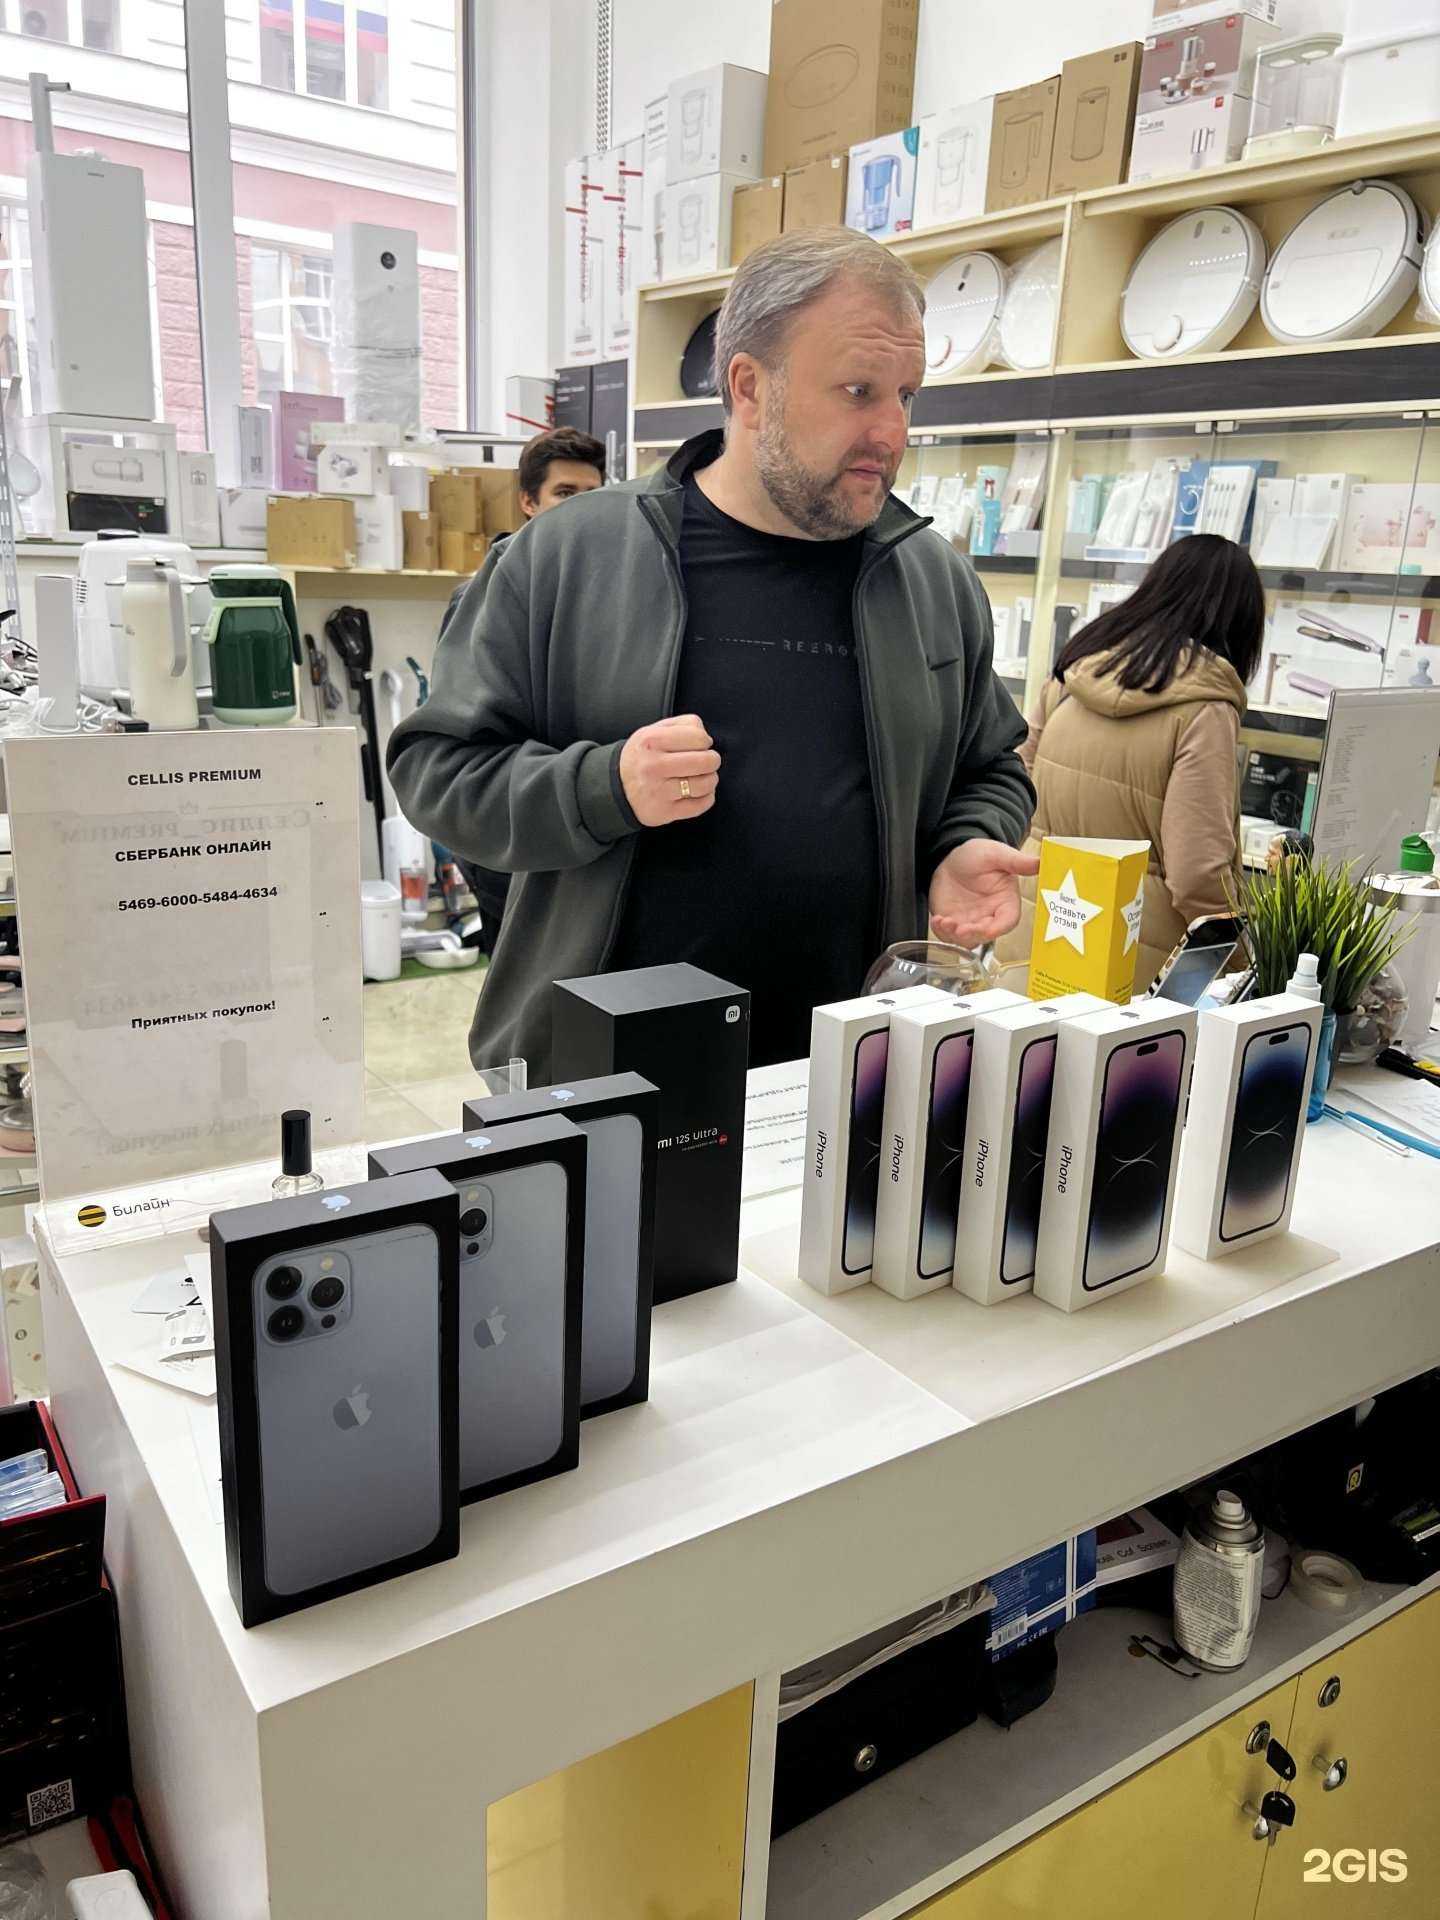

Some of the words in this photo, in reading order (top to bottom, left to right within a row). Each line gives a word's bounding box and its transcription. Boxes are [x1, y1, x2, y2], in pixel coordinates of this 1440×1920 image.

[127, 772, 184, 786] CELLIS
[188, 769, 262, 782] PREMIUM
[115, 846, 202, 862] СБЕРБАНК
[206, 839, 272, 855] ОНЛАЙН
[118, 886, 278, 911] 5469-6000-5484-4634
[1049, 901, 1087, 921] Оставьте
[1053, 916, 1078, 930] отзыв
[131, 1011, 207, 1030] Приятных
[212, 1000, 277, 1018] покупок!
[675, 1133, 690, 1145] 12S
[693, 1127, 718, 1141] Ultra
[815, 1129, 827, 1178] iPhone
[891, 1134, 904, 1183] iPhone
[975, 1138, 989, 1187] iPhone
[1057, 1144, 1073, 1194] iPhone
[113, 1198, 170, 1217] Билайн
